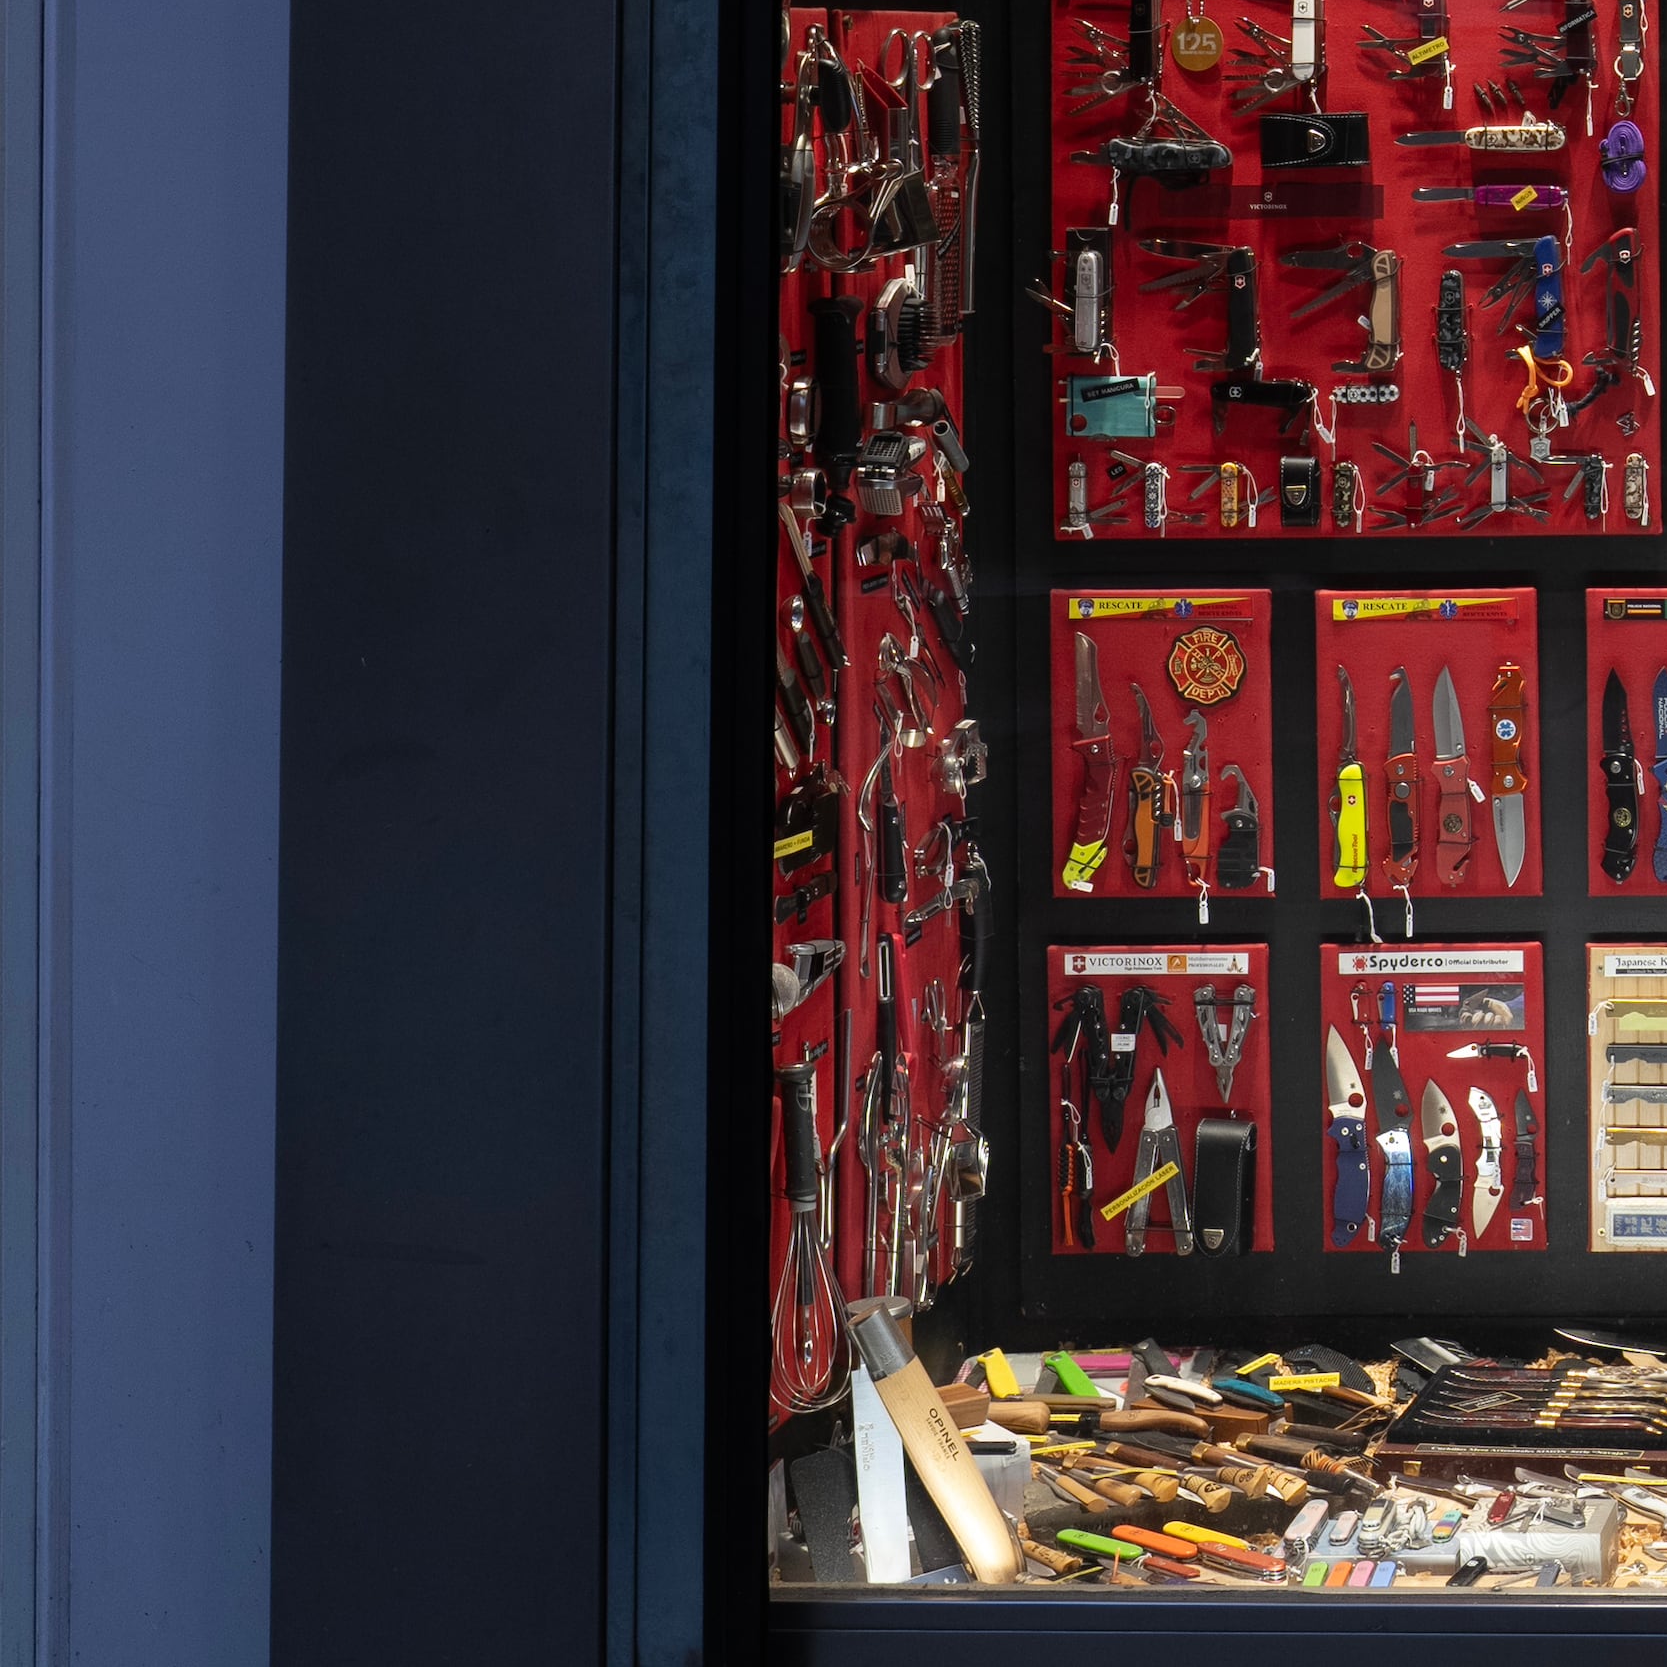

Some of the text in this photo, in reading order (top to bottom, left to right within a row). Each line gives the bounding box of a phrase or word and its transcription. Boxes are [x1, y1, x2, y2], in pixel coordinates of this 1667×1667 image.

[1177, 32, 1217, 51] 125
[1098, 602, 1144, 611] RESCATE
[1362, 602, 1408, 611] RESCATE
[1192, 631, 1219, 643] FIRE
[1089, 957, 1162, 967] VICTORINOX
[1369, 955, 1443, 971] Spyderco
[1473, 957, 1509, 965] Distributor
[1615, 957, 1657, 968] Japanese
[928, 1407, 959, 1462] OPINEL
